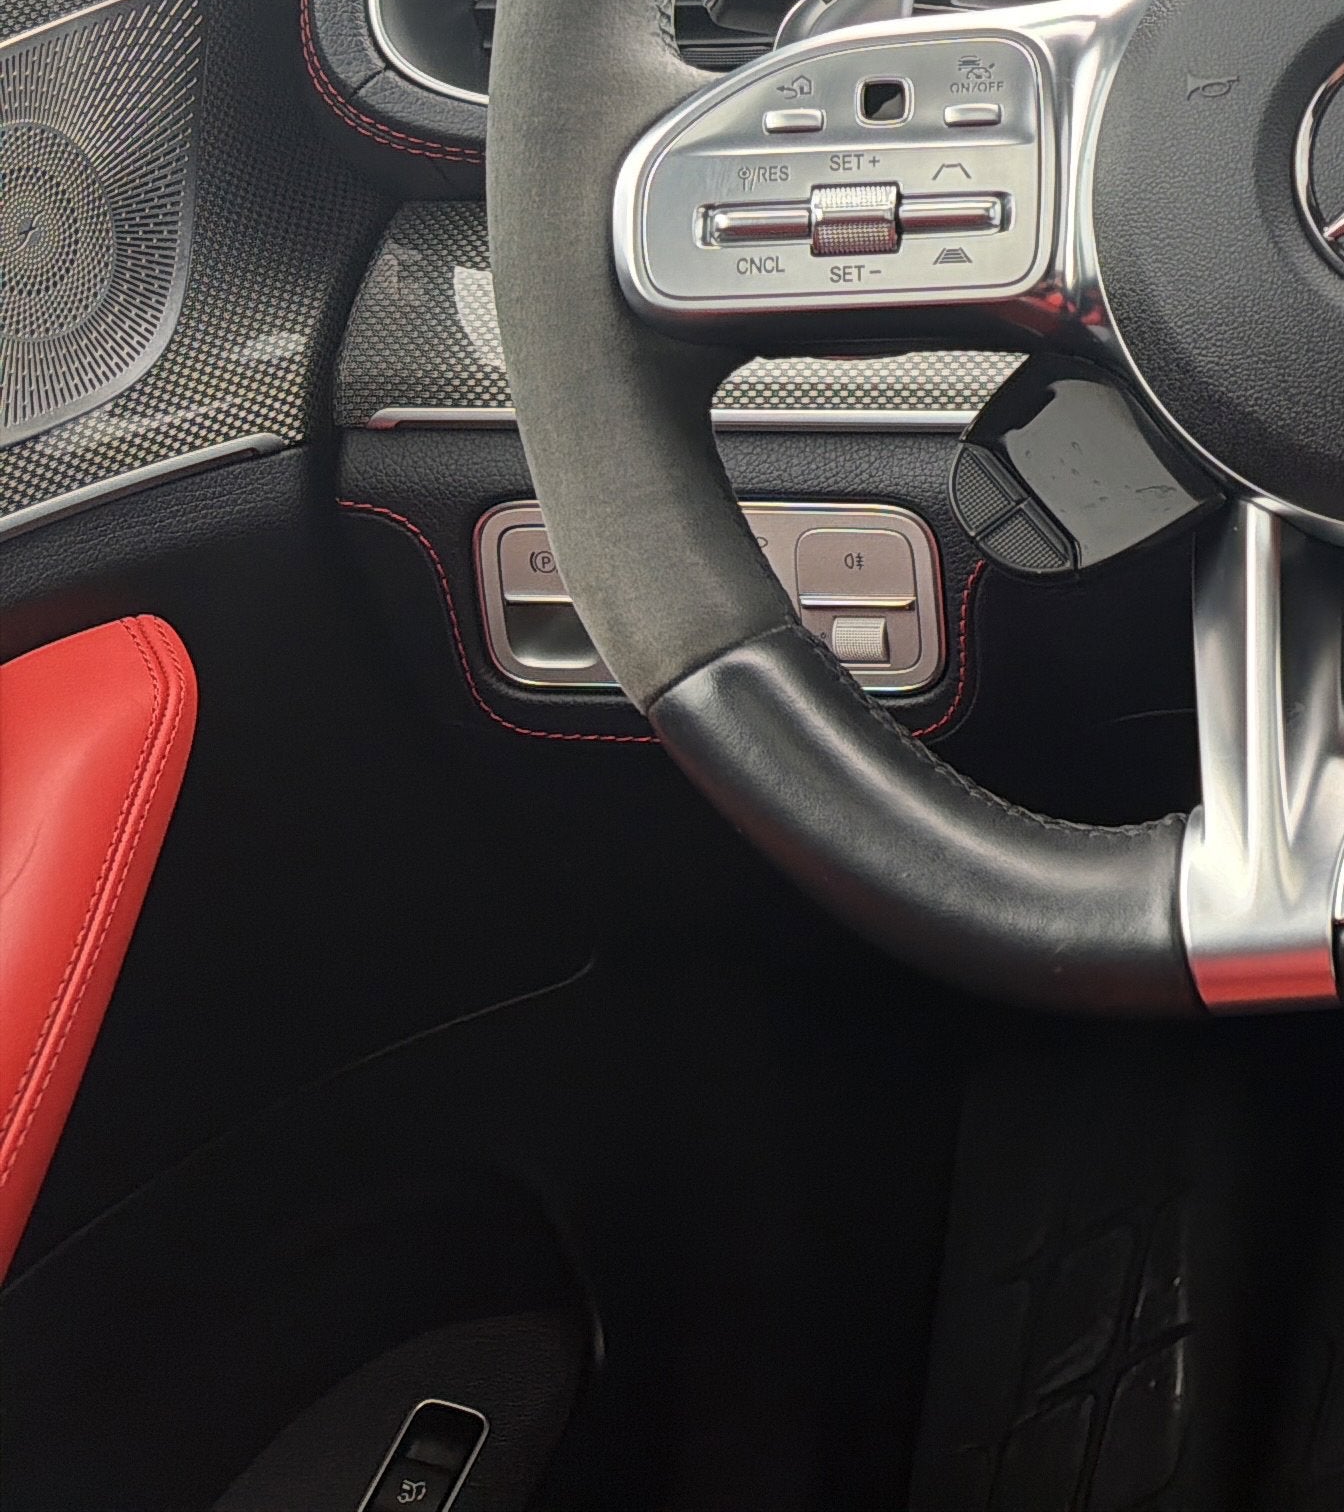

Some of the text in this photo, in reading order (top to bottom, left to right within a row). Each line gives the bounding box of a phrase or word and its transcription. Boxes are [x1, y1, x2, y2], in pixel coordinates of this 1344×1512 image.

[950, 81, 1004, 94] ON/OFF
[829, 154, 865, 172] SET
[736, 256, 786, 275] CNCL
[829, 265, 866, 283] SET
